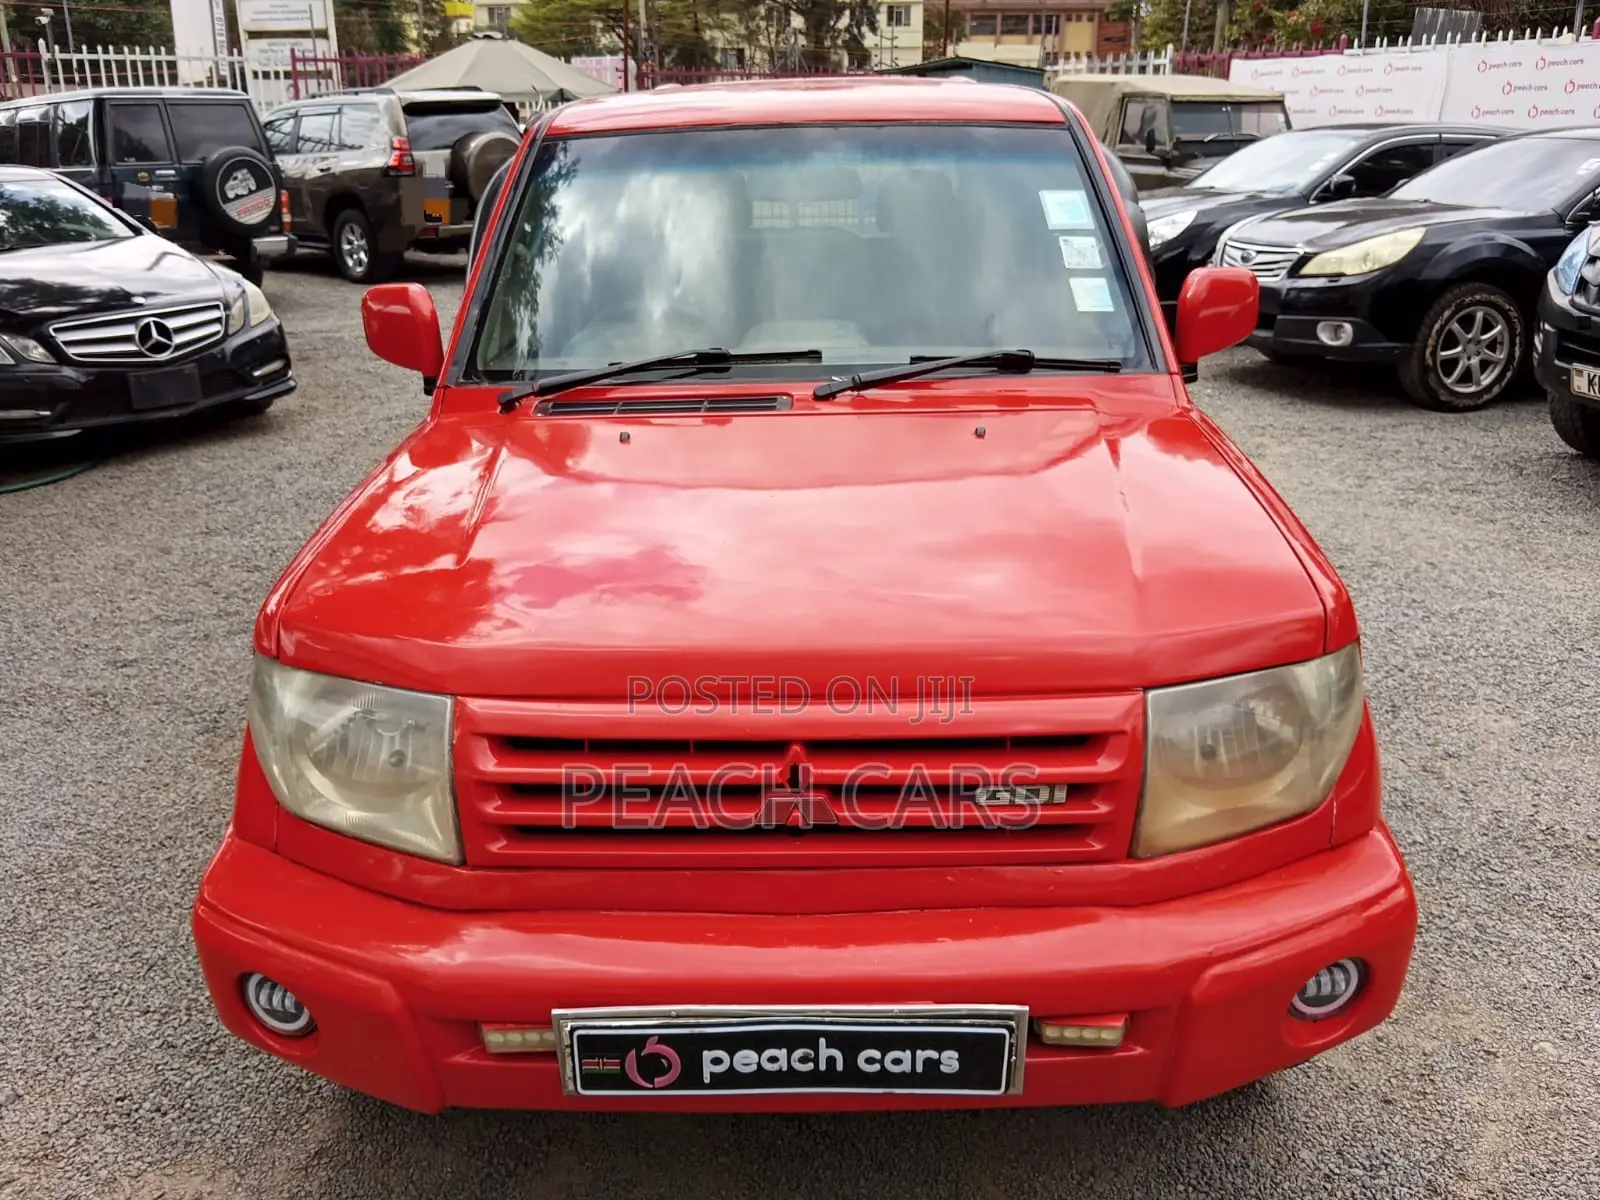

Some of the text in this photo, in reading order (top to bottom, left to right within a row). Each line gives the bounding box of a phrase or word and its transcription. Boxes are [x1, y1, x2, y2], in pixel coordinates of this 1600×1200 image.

[1488, 62, 1508, 71] peach
[1548, 58, 1584, 68] peach cars
[1513, 84, 1533, 93] peach
[1577, 82, 1597, 91] peach
[1540, 108, 1560, 117] peach
[1587, 372, 1600, 396] K
[975, 785, 1067, 806] GDI
[702, 1037, 960, 1084] peach cars
